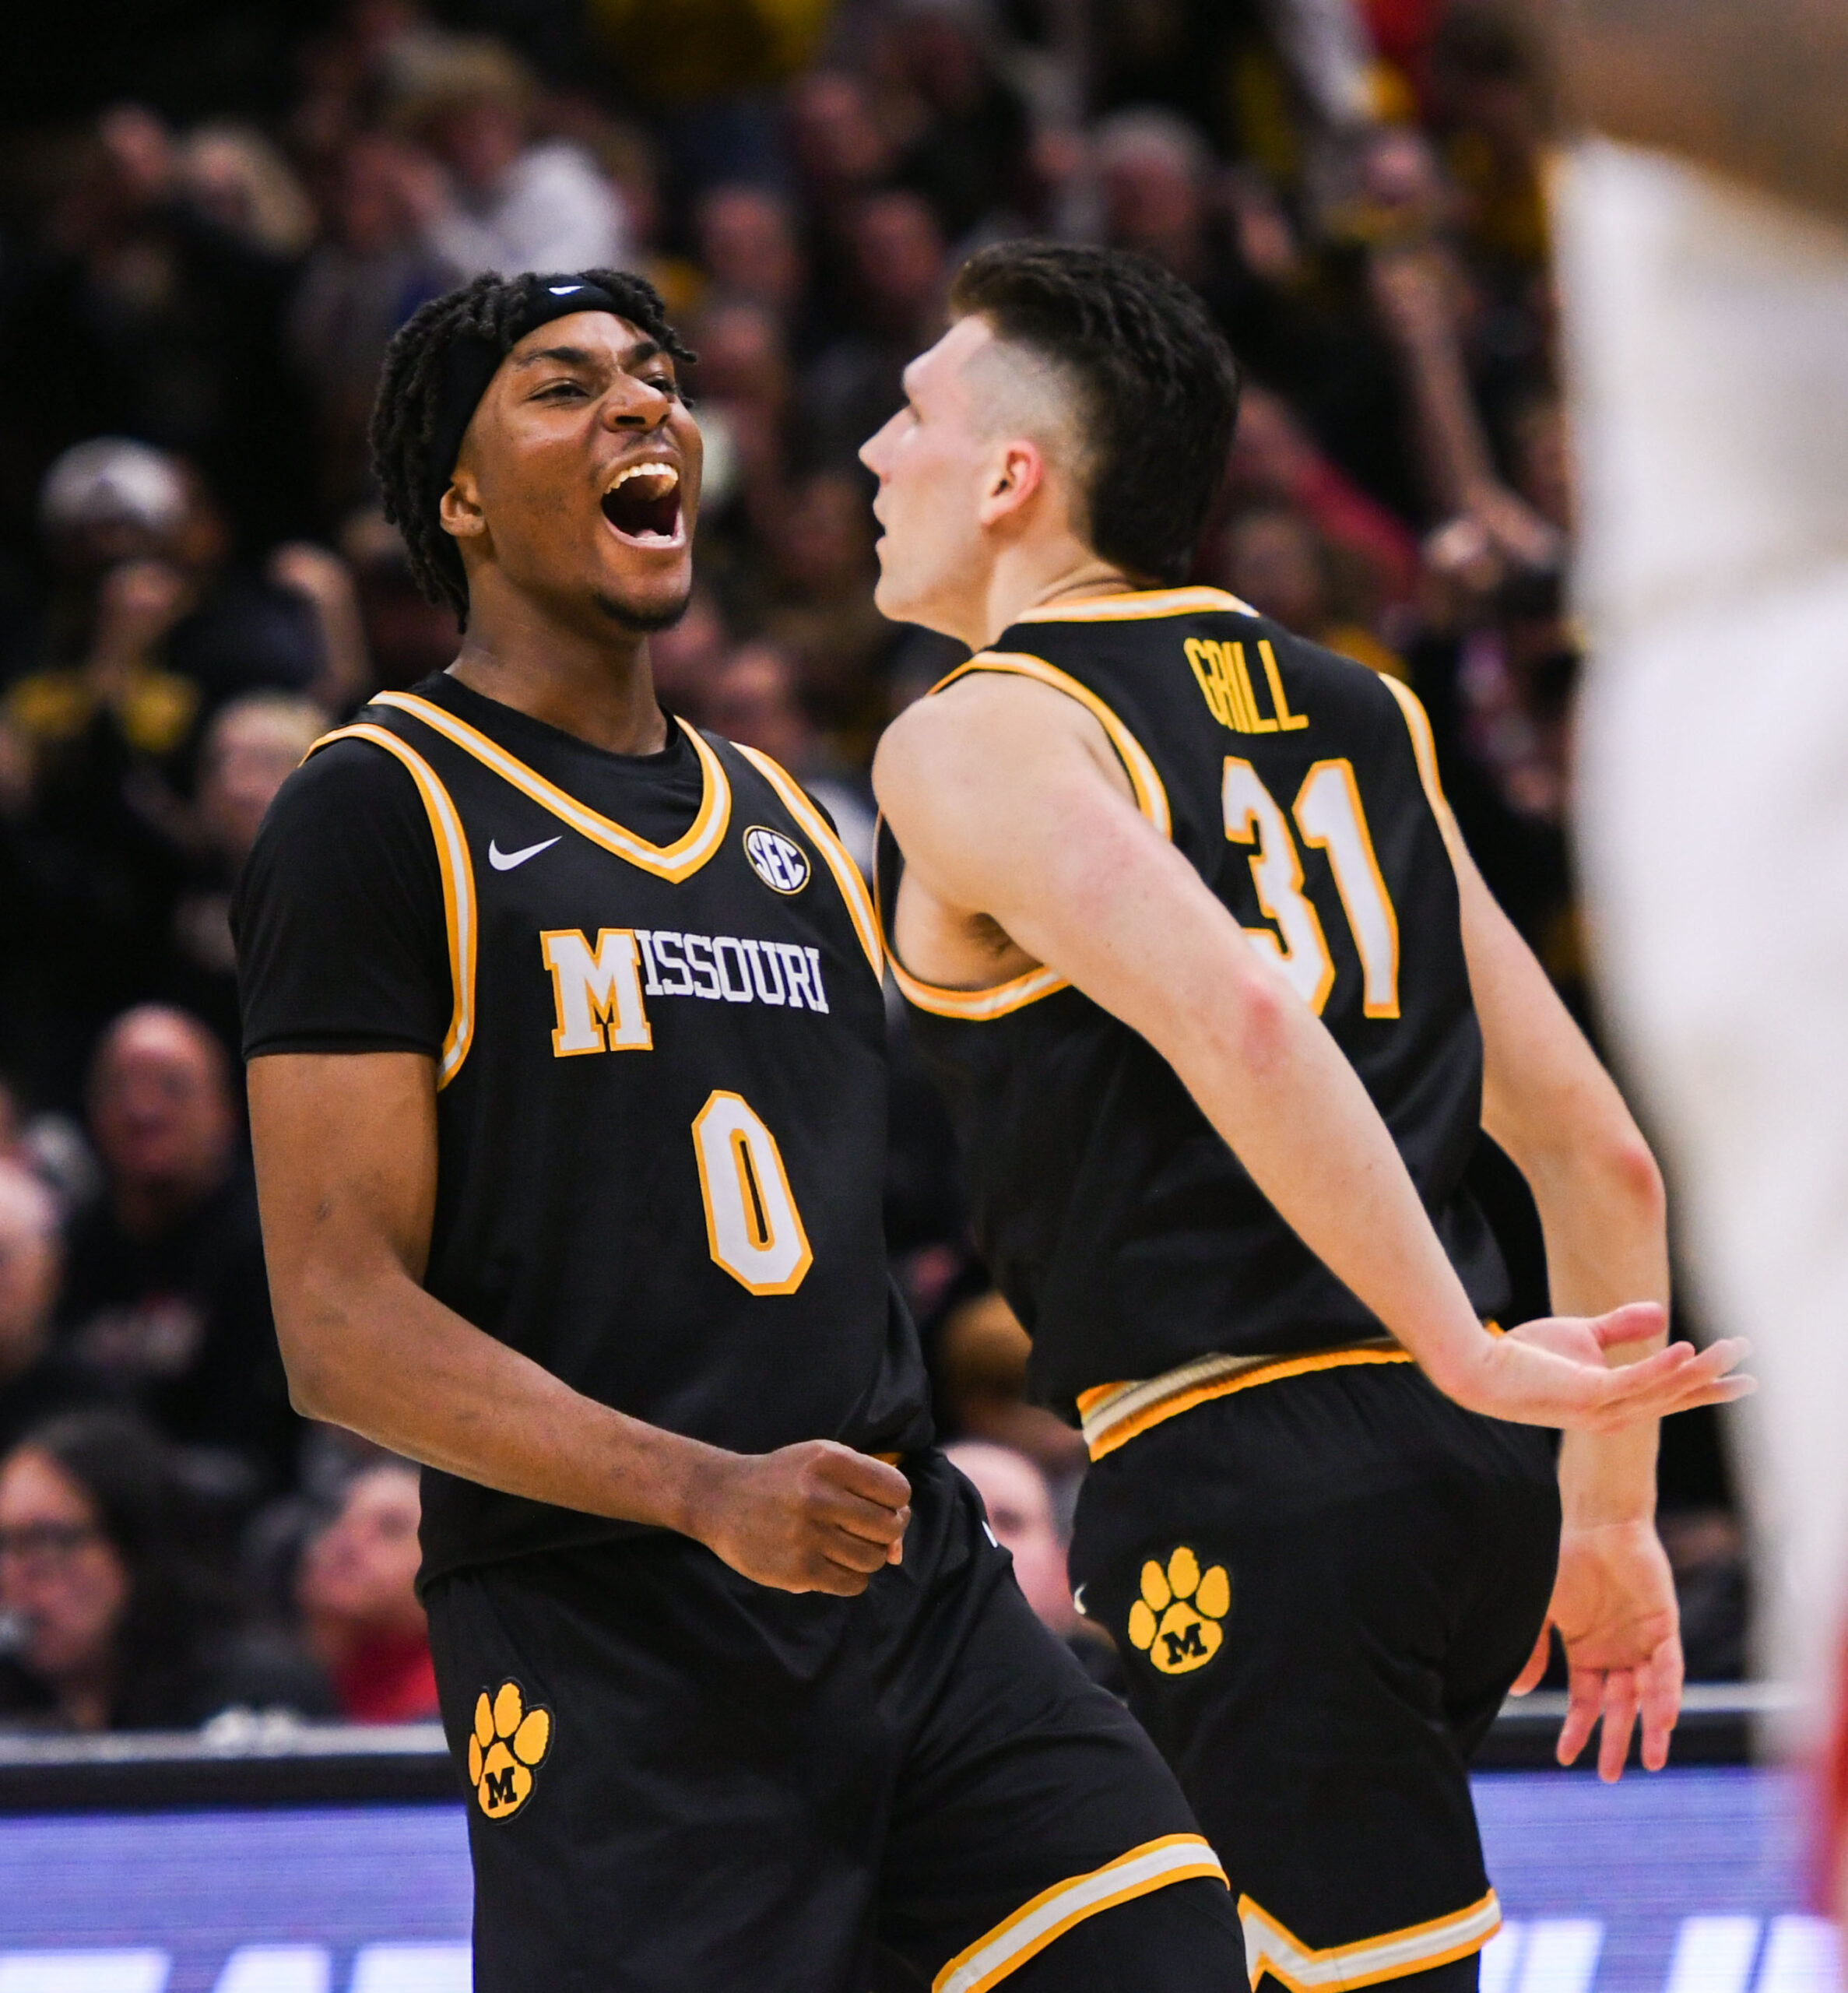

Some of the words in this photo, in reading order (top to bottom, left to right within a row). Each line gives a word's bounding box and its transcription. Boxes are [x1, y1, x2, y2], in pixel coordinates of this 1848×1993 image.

[1183, 638, 1309, 733] GRILL
[747, 830, 805, 891] SEC
[1221, 755, 1400, 1019] 31
[539, 928, 829, 1057] MISSOURI
[691, 1090, 813, 1295] 0
[1161, 1622, 1208, 1666] M
[485, 1766, 517, 1810] M
